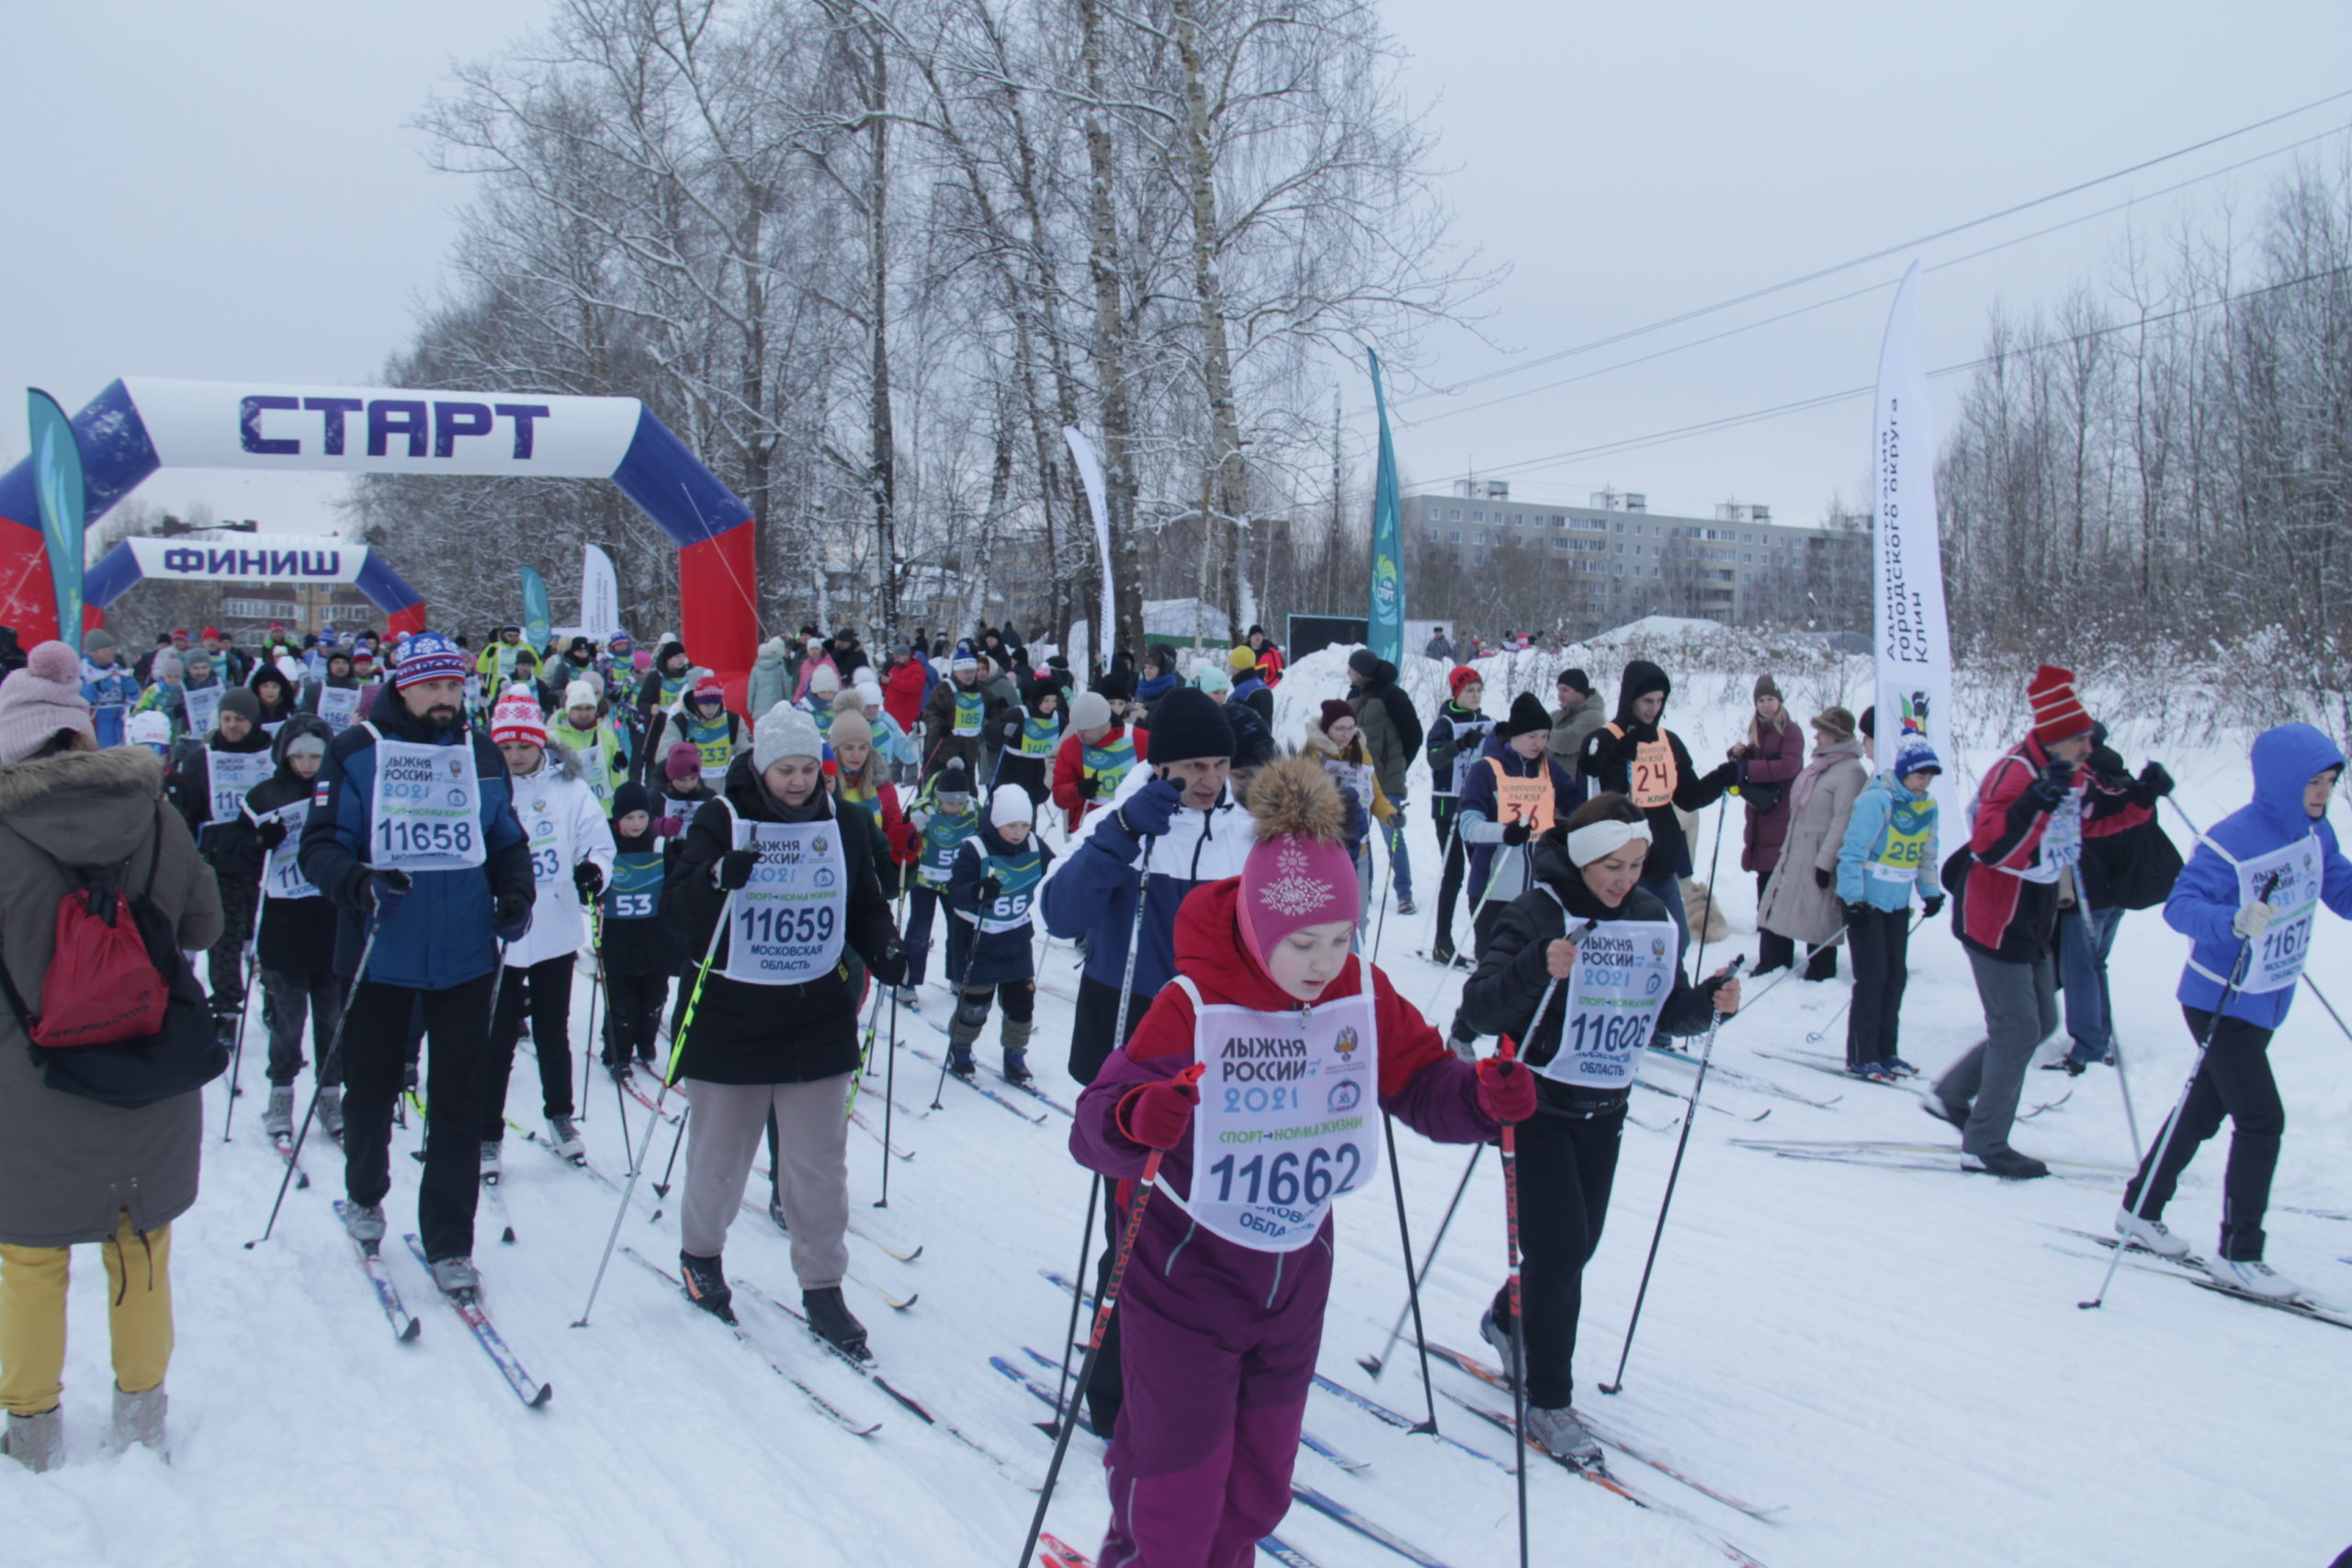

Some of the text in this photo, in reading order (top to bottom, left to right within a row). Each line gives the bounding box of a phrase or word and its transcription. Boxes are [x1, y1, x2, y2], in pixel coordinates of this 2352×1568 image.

[240, 395, 551, 460] СТАРТ
[1890, 399, 1913, 661] городского округа
[164, 548, 340, 576] ФИНИШ
[1912, 592, 1928, 662] Клин
[961, 713, 980, 724] 185
[386, 756, 433, 769] ЛЫЖНЯ
[384, 769, 434, 782] РОССИИ
[1637, 763, 1668, 793] 24
[382, 784, 430, 799] 2021
[1507, 803, 1540, 830] 36
[379, 818, 472, 852] 11658
[756, 840, 800, 852] ЫЖНЯ
[757, 852, 800, 864] ОССИИ
[749, 867, 796, 883] 2021
[616, 894, 652, 916] 53
[994, 895, 1027, 917] 66
[741, 906, 834, 943] 11659
[751, 944, 823, 956] МОСКОВСКАЯ
[1581, 937, 1634, 952] ЛЫЖНЯ
[760, 959, 810, 970] ОБЛАСТЬ
[1581, 952, 1634, 967] РОССИИ
[1583, 969, 1631, 987] 2021
[1220, 1037, 1307, 1058] ЛЫЖНЯ
[1223, 1060, 1307, 1082] РОССИИ
[1579, 1061, 1624, 1076] ОБЛАСТЬ
[1223, 1086, 1298, 1112] 2021
[1219, 1130, 1264, 1144] СПОРТ
[1210, 1143, 1361, 1205] 11662
